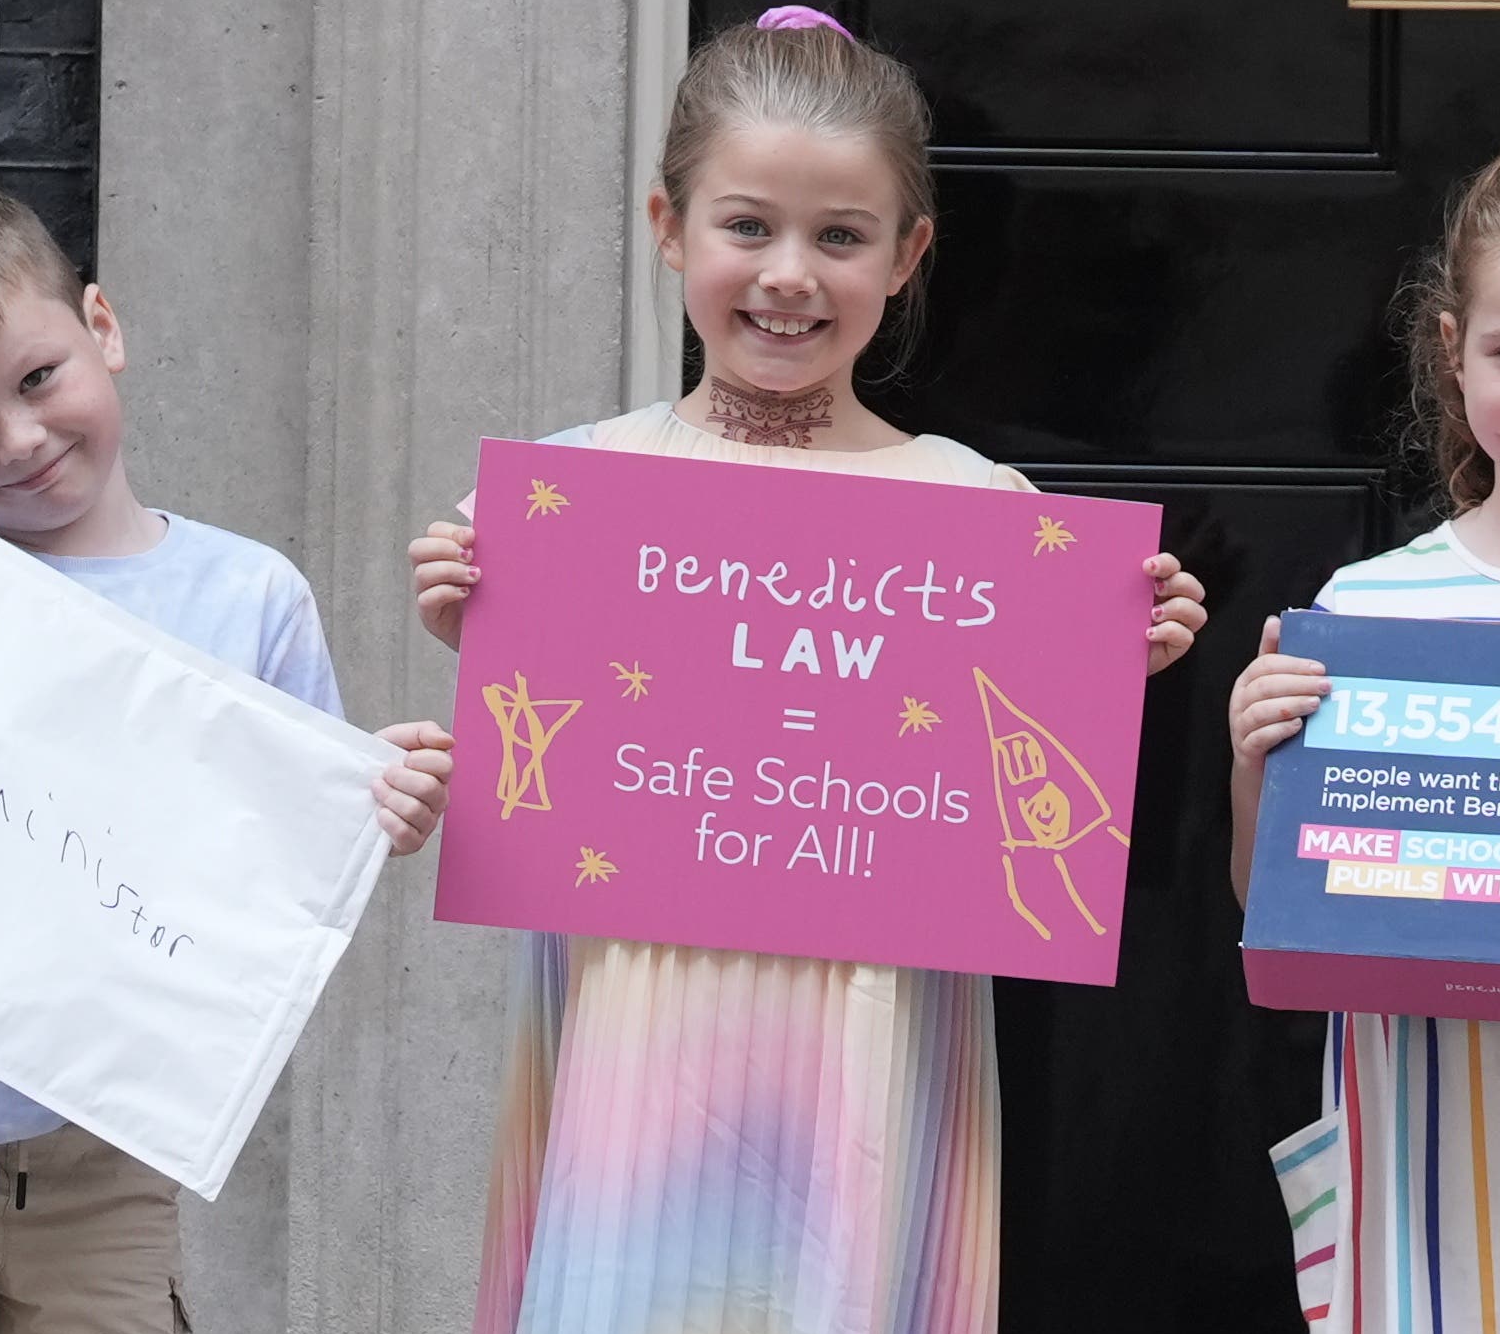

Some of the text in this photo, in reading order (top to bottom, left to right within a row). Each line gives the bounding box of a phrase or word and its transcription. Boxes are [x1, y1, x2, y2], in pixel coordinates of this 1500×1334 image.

[637, 543, 997, 627] Benedict's
[731, 622, 885, 680] LAW
[613, 744, 970, 824] Safe Schools
[1324, 765, 1412, 787] people
[1419, 771, 1482, 791] want
[1321, 787, 1455, 813] implement
[695, 812, 875, 877] for All!
[1303, 829, 1396, 858] MAKE
[1332, 866, 1439, 893] PUPILS
